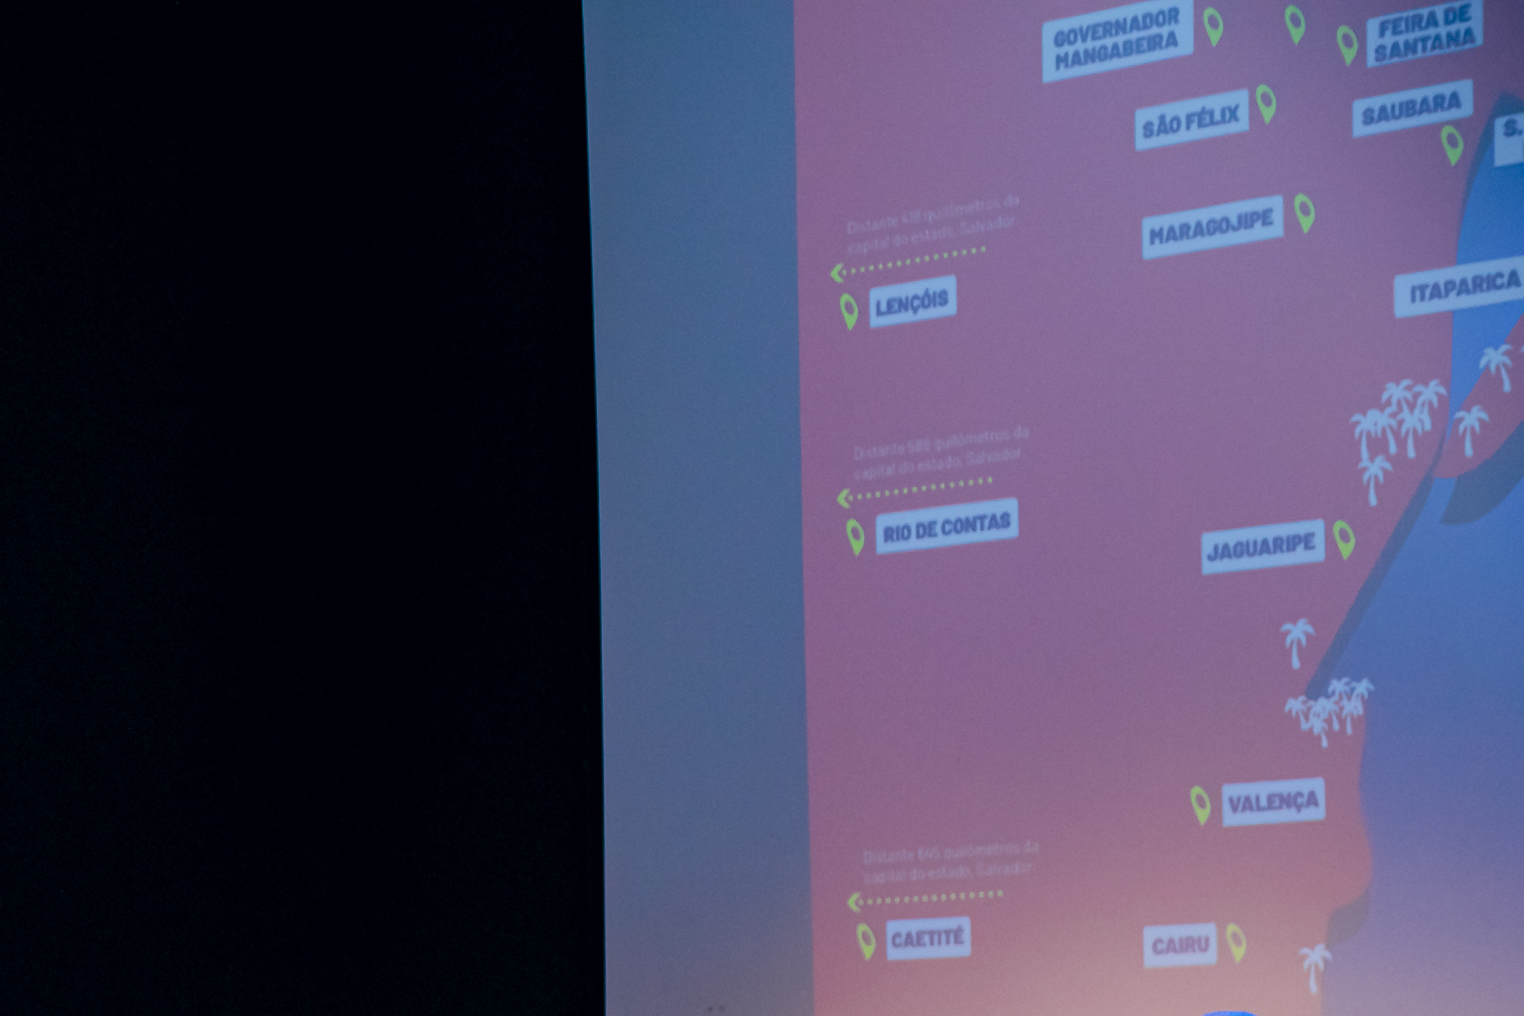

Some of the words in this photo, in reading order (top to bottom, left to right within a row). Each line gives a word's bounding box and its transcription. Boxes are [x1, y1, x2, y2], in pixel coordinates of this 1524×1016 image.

[1054, 7, 1179, 48] GOVERNADOR
[1378, 10, 1439, 38] FEIRA
[1443, 3, 1472, 26] DE
[1055, 30, 1178, 71] MANGABEIRA
[1375, 27, 1476, 62] SANTANA
[1142, 112, 1181, 138] SÃO
[1184, 104, 1240, 131] FÉLIX
[1362, 91, 1463, 126] SAUBARA
[1148, 207, 1274, 246] MARAGOJIPE
[876, 288, 949, 317] LENÇÓIS
[1409, 268, 1523, 303] ITAPARICA
[883, 523, 912, 543] RIO
[916, 520, 938, 539] DE
[941, 511, 1011, 536] CONTAS
[1207, 531, 1316, 562] JAGUARIPE
[1227, 789, 1320, 813] VALENÇA
[891, 924, 965, 950] CAETITÉ
[1151, 935, 1211, 956] CAIRU
